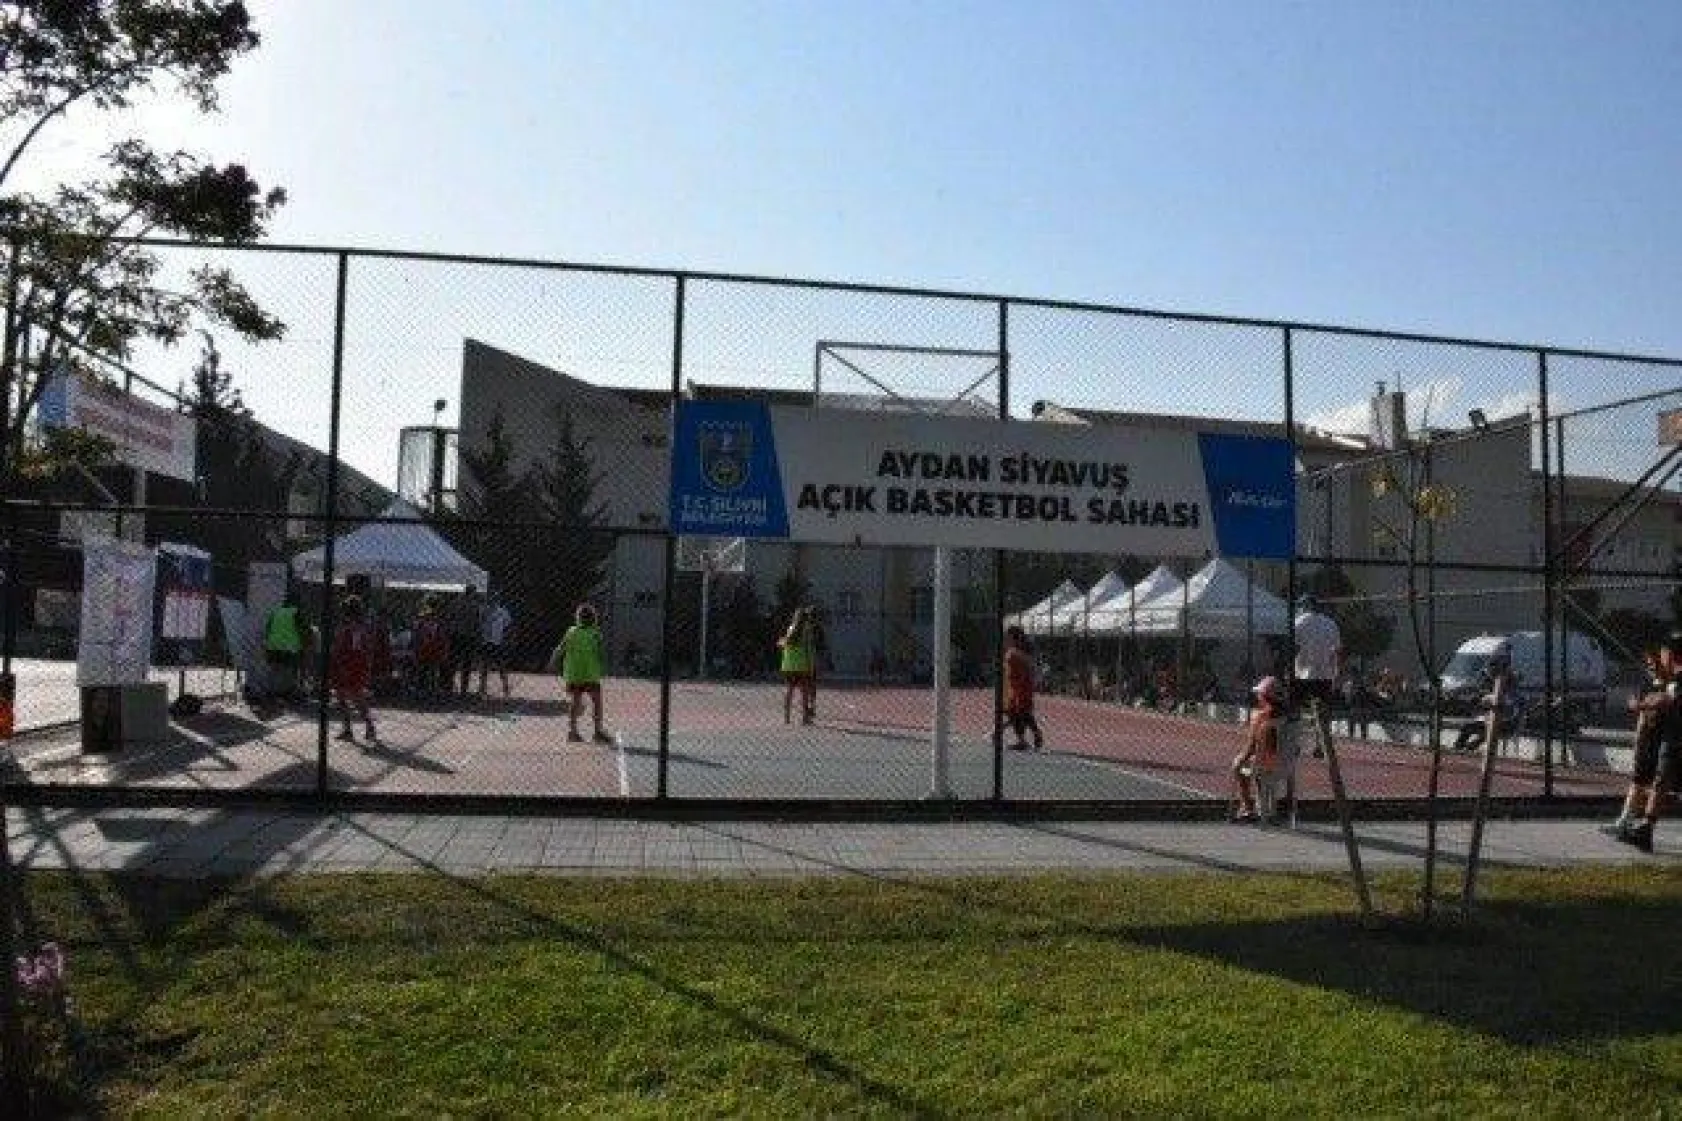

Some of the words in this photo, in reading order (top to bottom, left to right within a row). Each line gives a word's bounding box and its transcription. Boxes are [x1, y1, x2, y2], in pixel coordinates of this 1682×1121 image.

[877, 450, 990, 481] AYDAN
[999, 452, 1129, 494] SİYAVUŞ
[797, 484, 876, 518] AÇIK
[887, 488, 1077, 521] BASKETBOL
[1086, 496, 1200, 529] SAHASI
